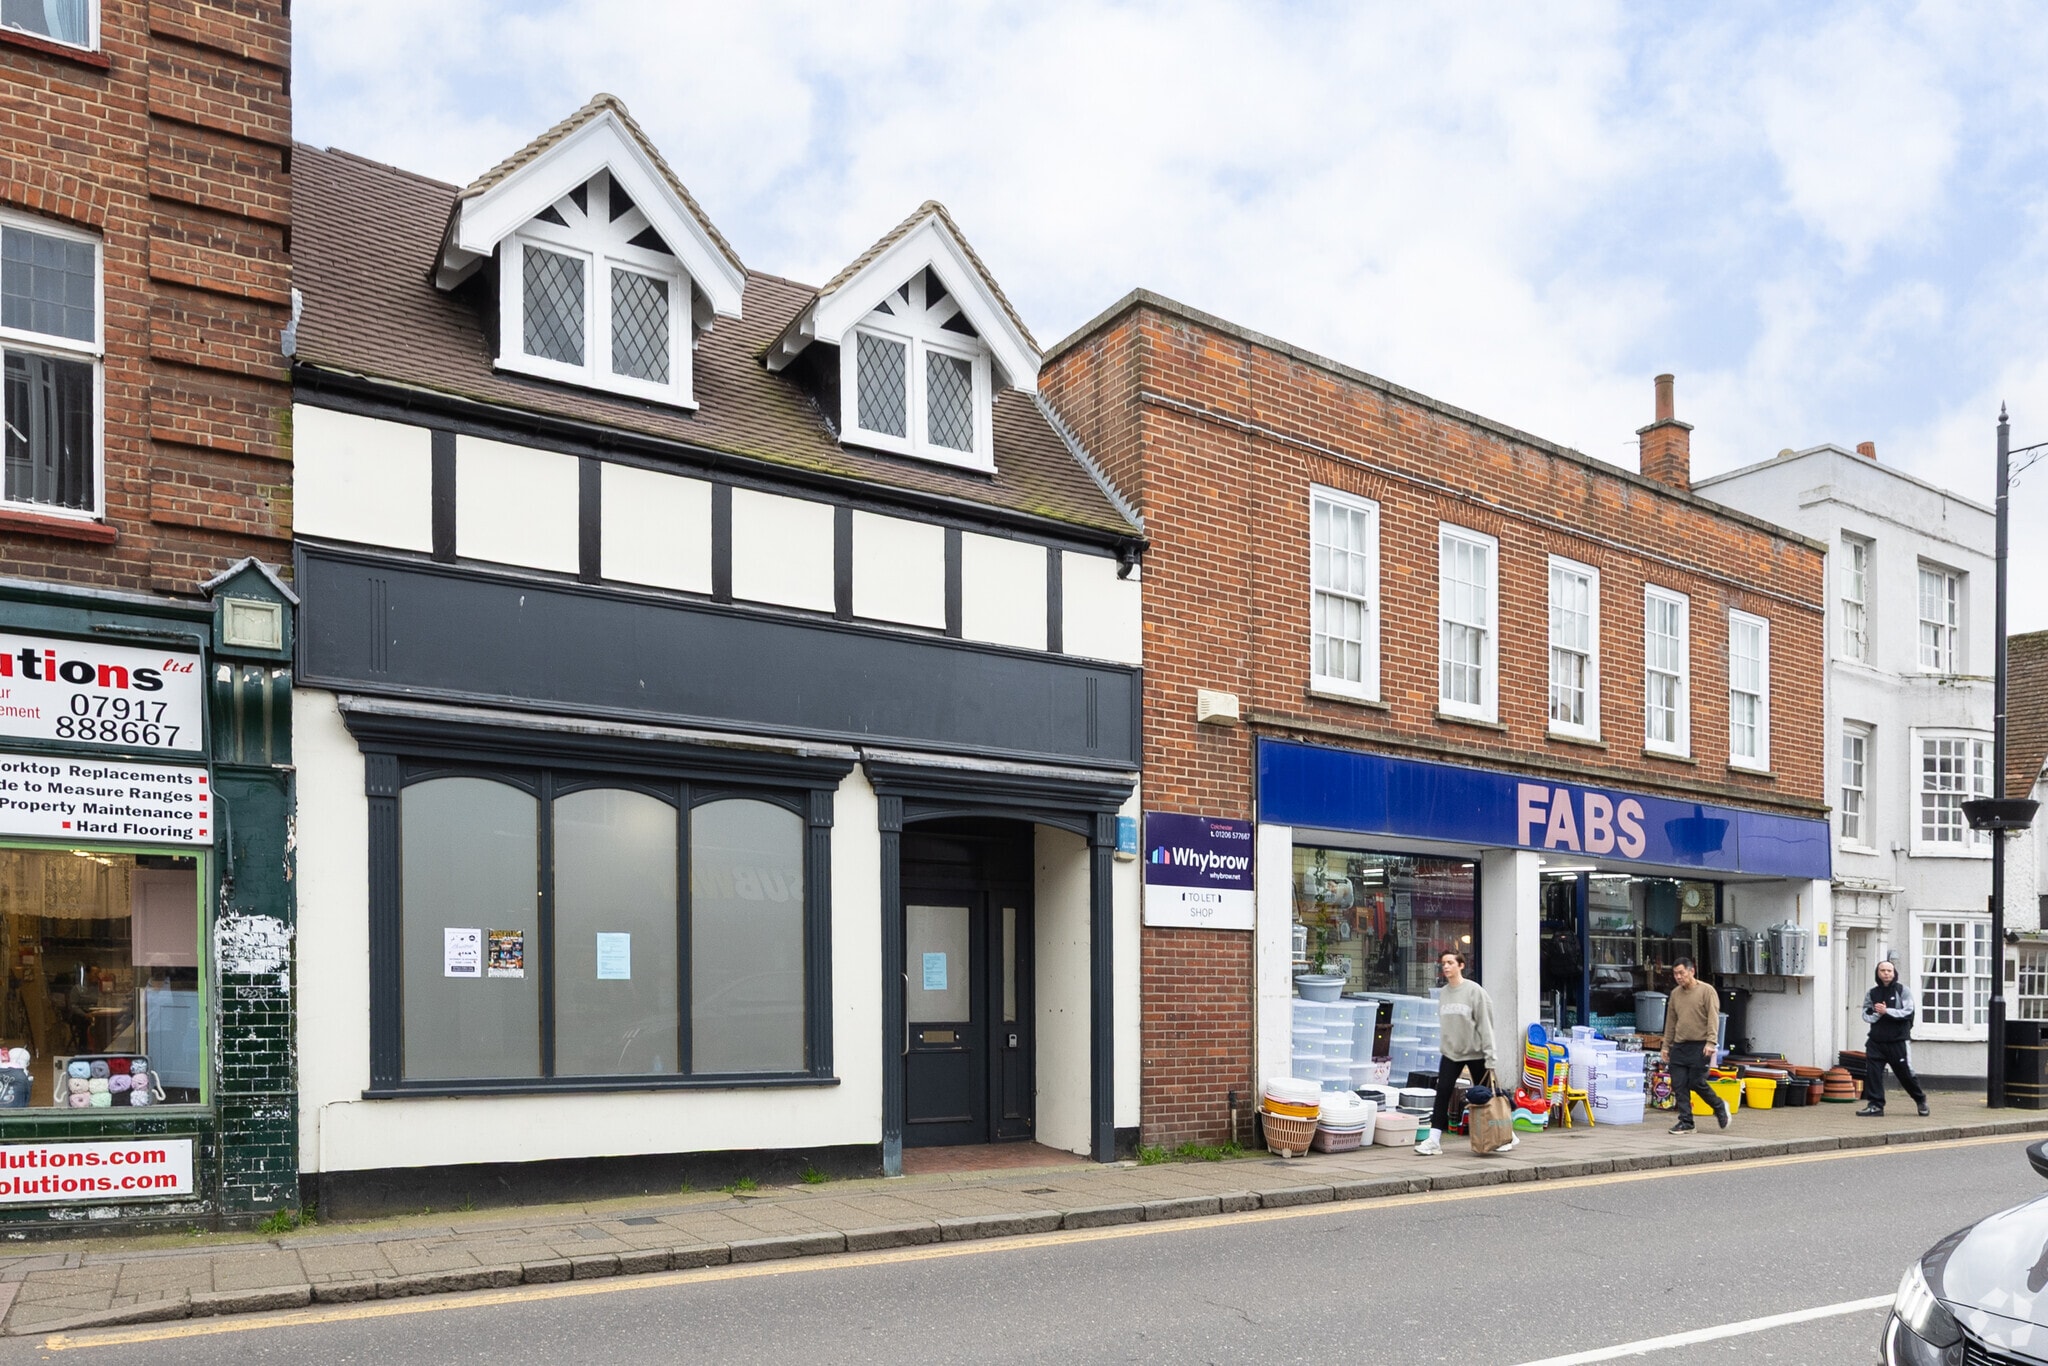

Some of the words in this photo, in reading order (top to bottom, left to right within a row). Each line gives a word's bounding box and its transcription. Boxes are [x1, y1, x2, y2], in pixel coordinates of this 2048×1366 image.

[162, 658, 194, 674] ltd
[70, 693, 168, 724] 07917
[55, 715, 181, 747] 888667
[0, 761, 61, 777] orktop
[69, 765, 193, 785] Replacements
[24, 780, 42, 792] to
[48, 782, 124, 798] Measure
[129, 787, 193, 804] Ranges
[0, 797, 76, 815] Property
[83, 802, 193, 820] Maintenance
[77, 820, 117, 834] Hard
[123, 822, 193, 840] Flooring
[1517, 782, 1647, 859] FABS
[1172, 846, 1249, 872] Whybrow
[1189, 892, 1200, 902] TO
[1201, 893, 1216, 903] LET
[1190, 907, 1214, 918] SHOP
[0, 1149, 166, 1169] lutions.com
